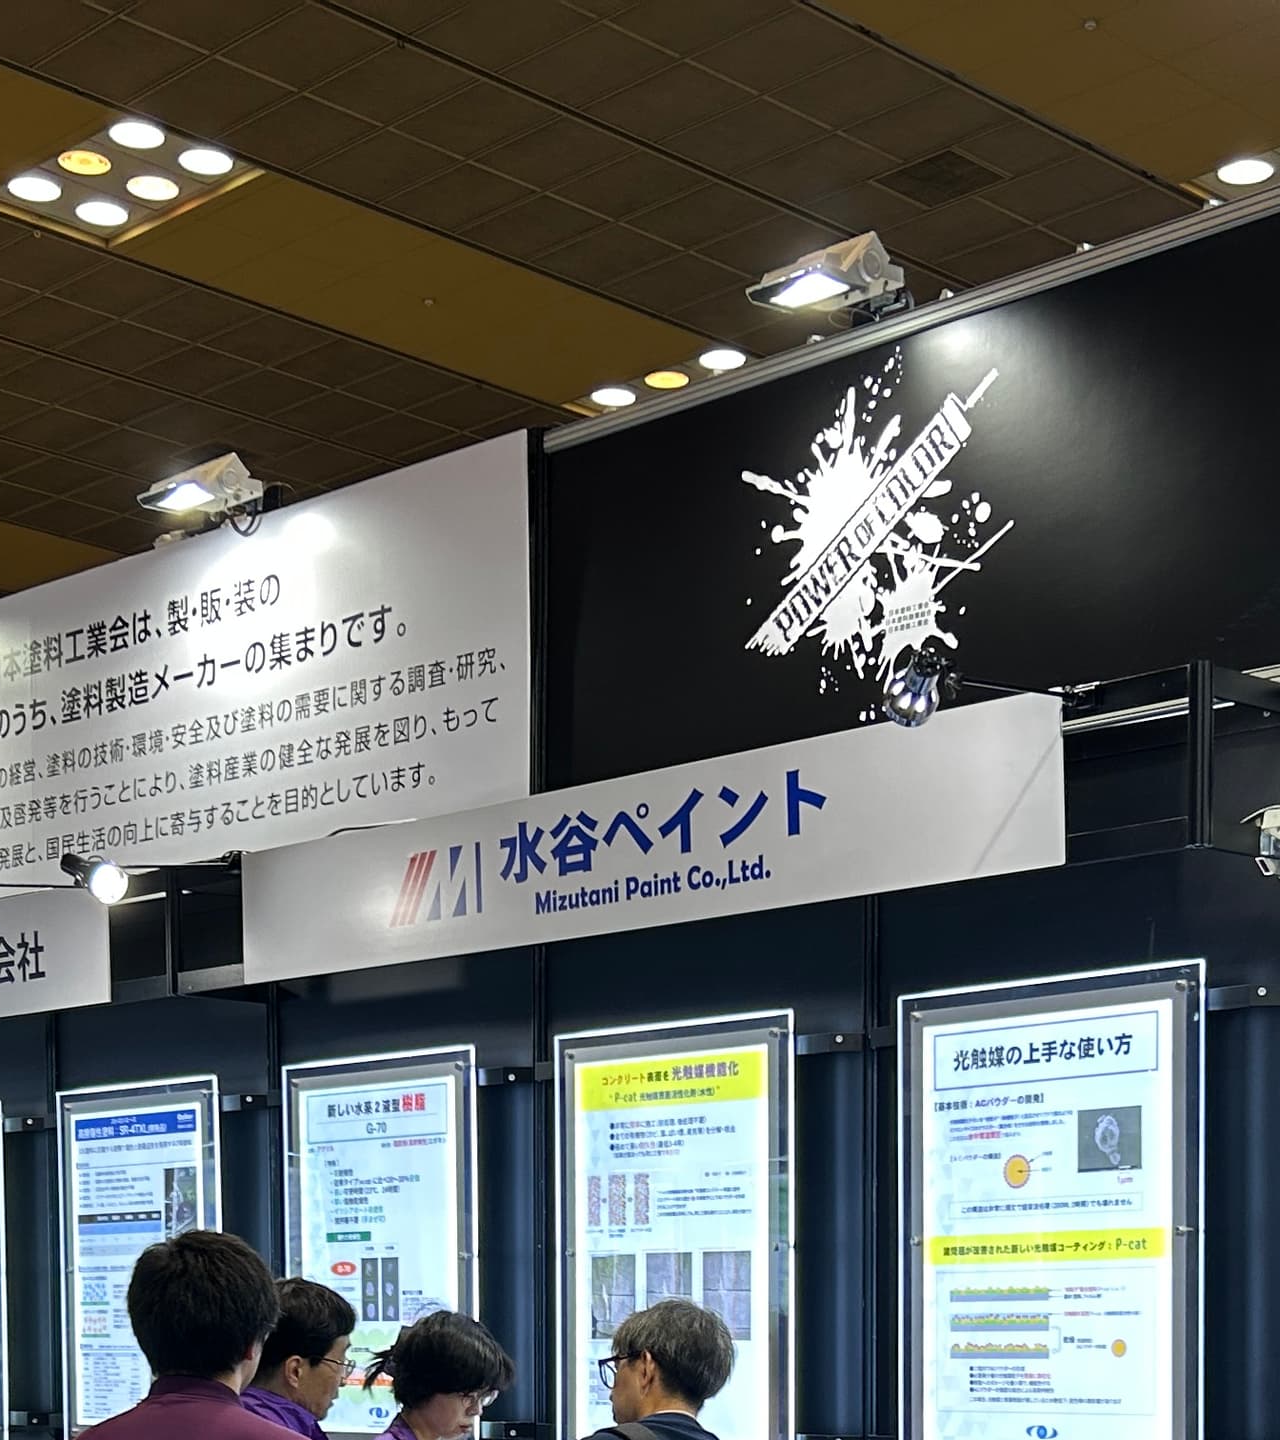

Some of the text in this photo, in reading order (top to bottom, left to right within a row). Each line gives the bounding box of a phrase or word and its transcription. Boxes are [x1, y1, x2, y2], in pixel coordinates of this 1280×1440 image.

[499, 769, 828, 884] 水谷ペイント
[535, 856, 771, 915] Mizutani Paint Co.,Ltd.
[953, 1033, 1133, 1072] 光触媒の上手な使い方
